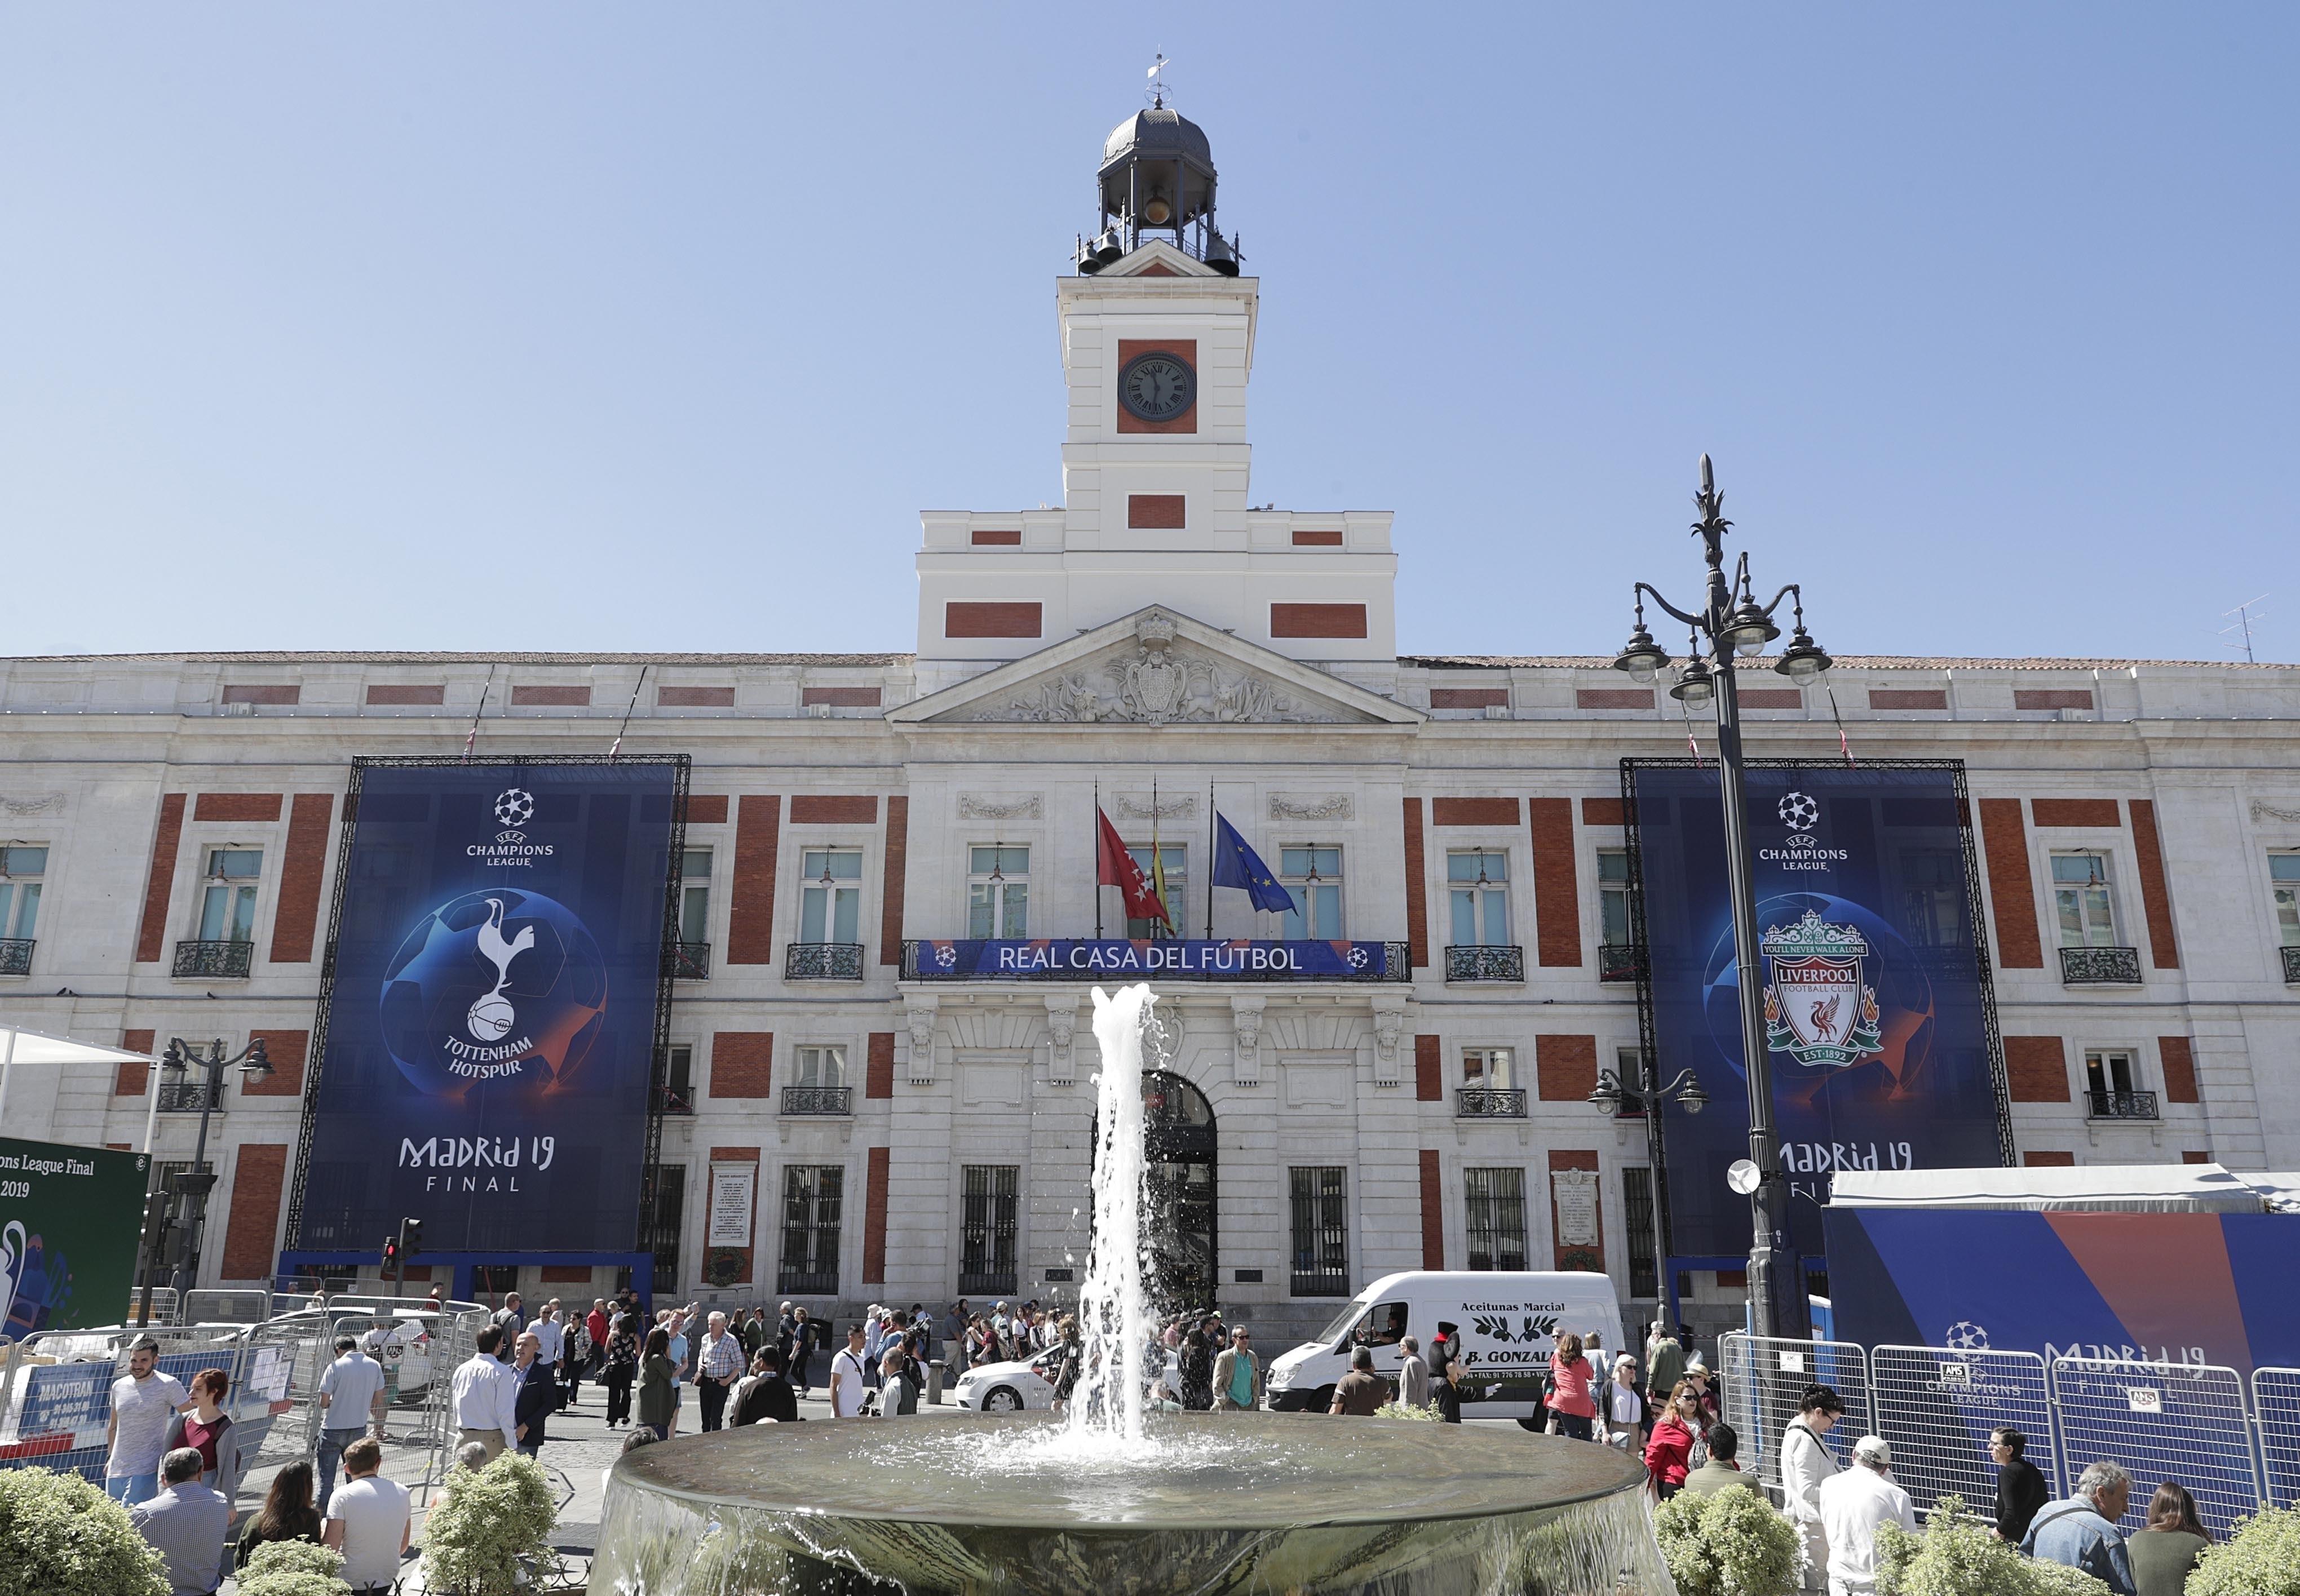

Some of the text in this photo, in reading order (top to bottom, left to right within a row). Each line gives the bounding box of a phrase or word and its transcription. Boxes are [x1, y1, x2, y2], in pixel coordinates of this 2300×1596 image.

[497, 832, 524, 843] UEFA
[1788, 837, 1815, 846] UEFA
[467, 845, 554, 856] CHAMPIONS
[1759, 849, 1848, 859] CHAMPIONS
[1000, 941, 1302, 970] REAL CASA DEL FÚTBOL
[1779, 969, 1856, 982] LIVERPOOL
[444, 1035, 533, 1061] TOTTENHAM
[448, 1058, 523, 1079] HOTSPUR
[532, 1136, 554, 1171] 19
[1889, 1142, 1912, 1170] 19
[21, 1155, 63, 1176] League
[65, 1159, 94, 1176] Final
[1, 1180, 30, 1198] 2019
[427, 1176, 519, 1191] FINAL
[1461, 1302, 1565, 1311] Aceitunas Marcial
[1488, 1351, 1553, 1362] GONZAL
[2181, 1346, 2206, 1379] 19
[1946, 1365, 1963, 1375] AMS
[1926, 1380, 2022, 1396] CHAMPIONS
[1950, 1395, 1998, 1406] LEAGUE
[2133, 1392, 2155, 1402] AMS
